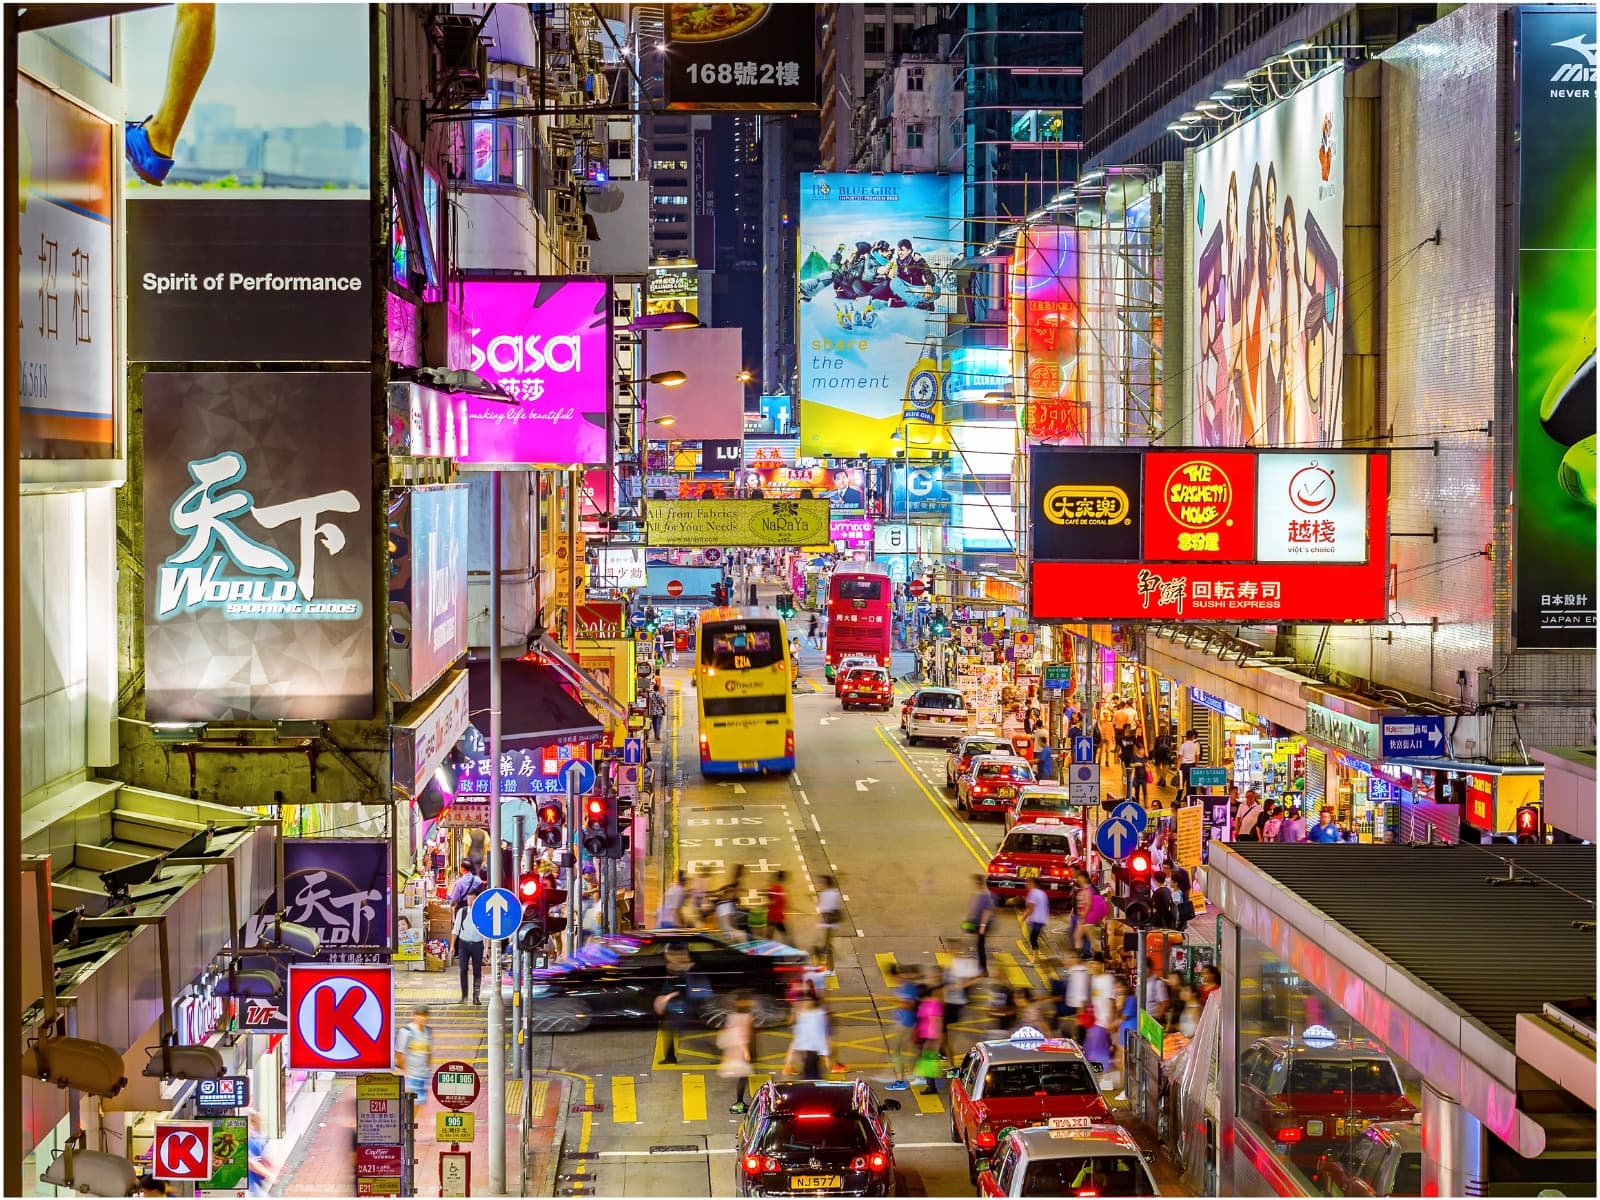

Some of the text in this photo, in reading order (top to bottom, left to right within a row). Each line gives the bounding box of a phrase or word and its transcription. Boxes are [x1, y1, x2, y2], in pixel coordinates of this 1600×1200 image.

[686, 61, 800, 86] 168號2樓
[1550, 89, 1590, 98] NEVER
[839, 186, 898, 196] BLUE GIRL
[142, 272, 362, 299] Spirit of Performance
[811, 337, 868, 351] share
[812, 355, 844, 370] the
[812, 376, 890, 390] moment
[469, 408, 574, 424] making life beautiful
[1183, 464, 1212, 483] THE
[666, 508, 693, 520] from
[696, 508, 738, 519] Fabrics
[1180, 505, 1220, 526] HOUSE
[166, 453, 361, 602] 天下
[661, 522, 678, 534] for
[680, 522, 703, 532] Your
[706, 522, 738, 532] Needs
[762, 517, 809, 532] NaRaYa
[1288, 520, 1336, 544] 越棧
[159, 556, 298, 615] WORLD
[1192, 600, 1281, 609] SUSHI EXPRESS
[1540, 594, 1588, 606] 日本設計
[226, 603, 357, 614] SPORTING GOODS
[1542, 616, 1581, 624] JAPAN
[687, 817, 764, 826] BUS
[679, 836, 782, 848] STOP
[293, 871, 382, 944] 天下
[315, 985, 377, 1052] K
[442, 1074, 472, 1084] 904 905
[371, 1100, 386, 1112] E21A
[448, 1117, 460, 1126] 905
[1052, 1119, 1088, 1128] TAXI
[167, 1134, 202, 1172] K
[798, 1177, 834, 1186] NJ 577
[360, 1184, 371, 1192] E21
